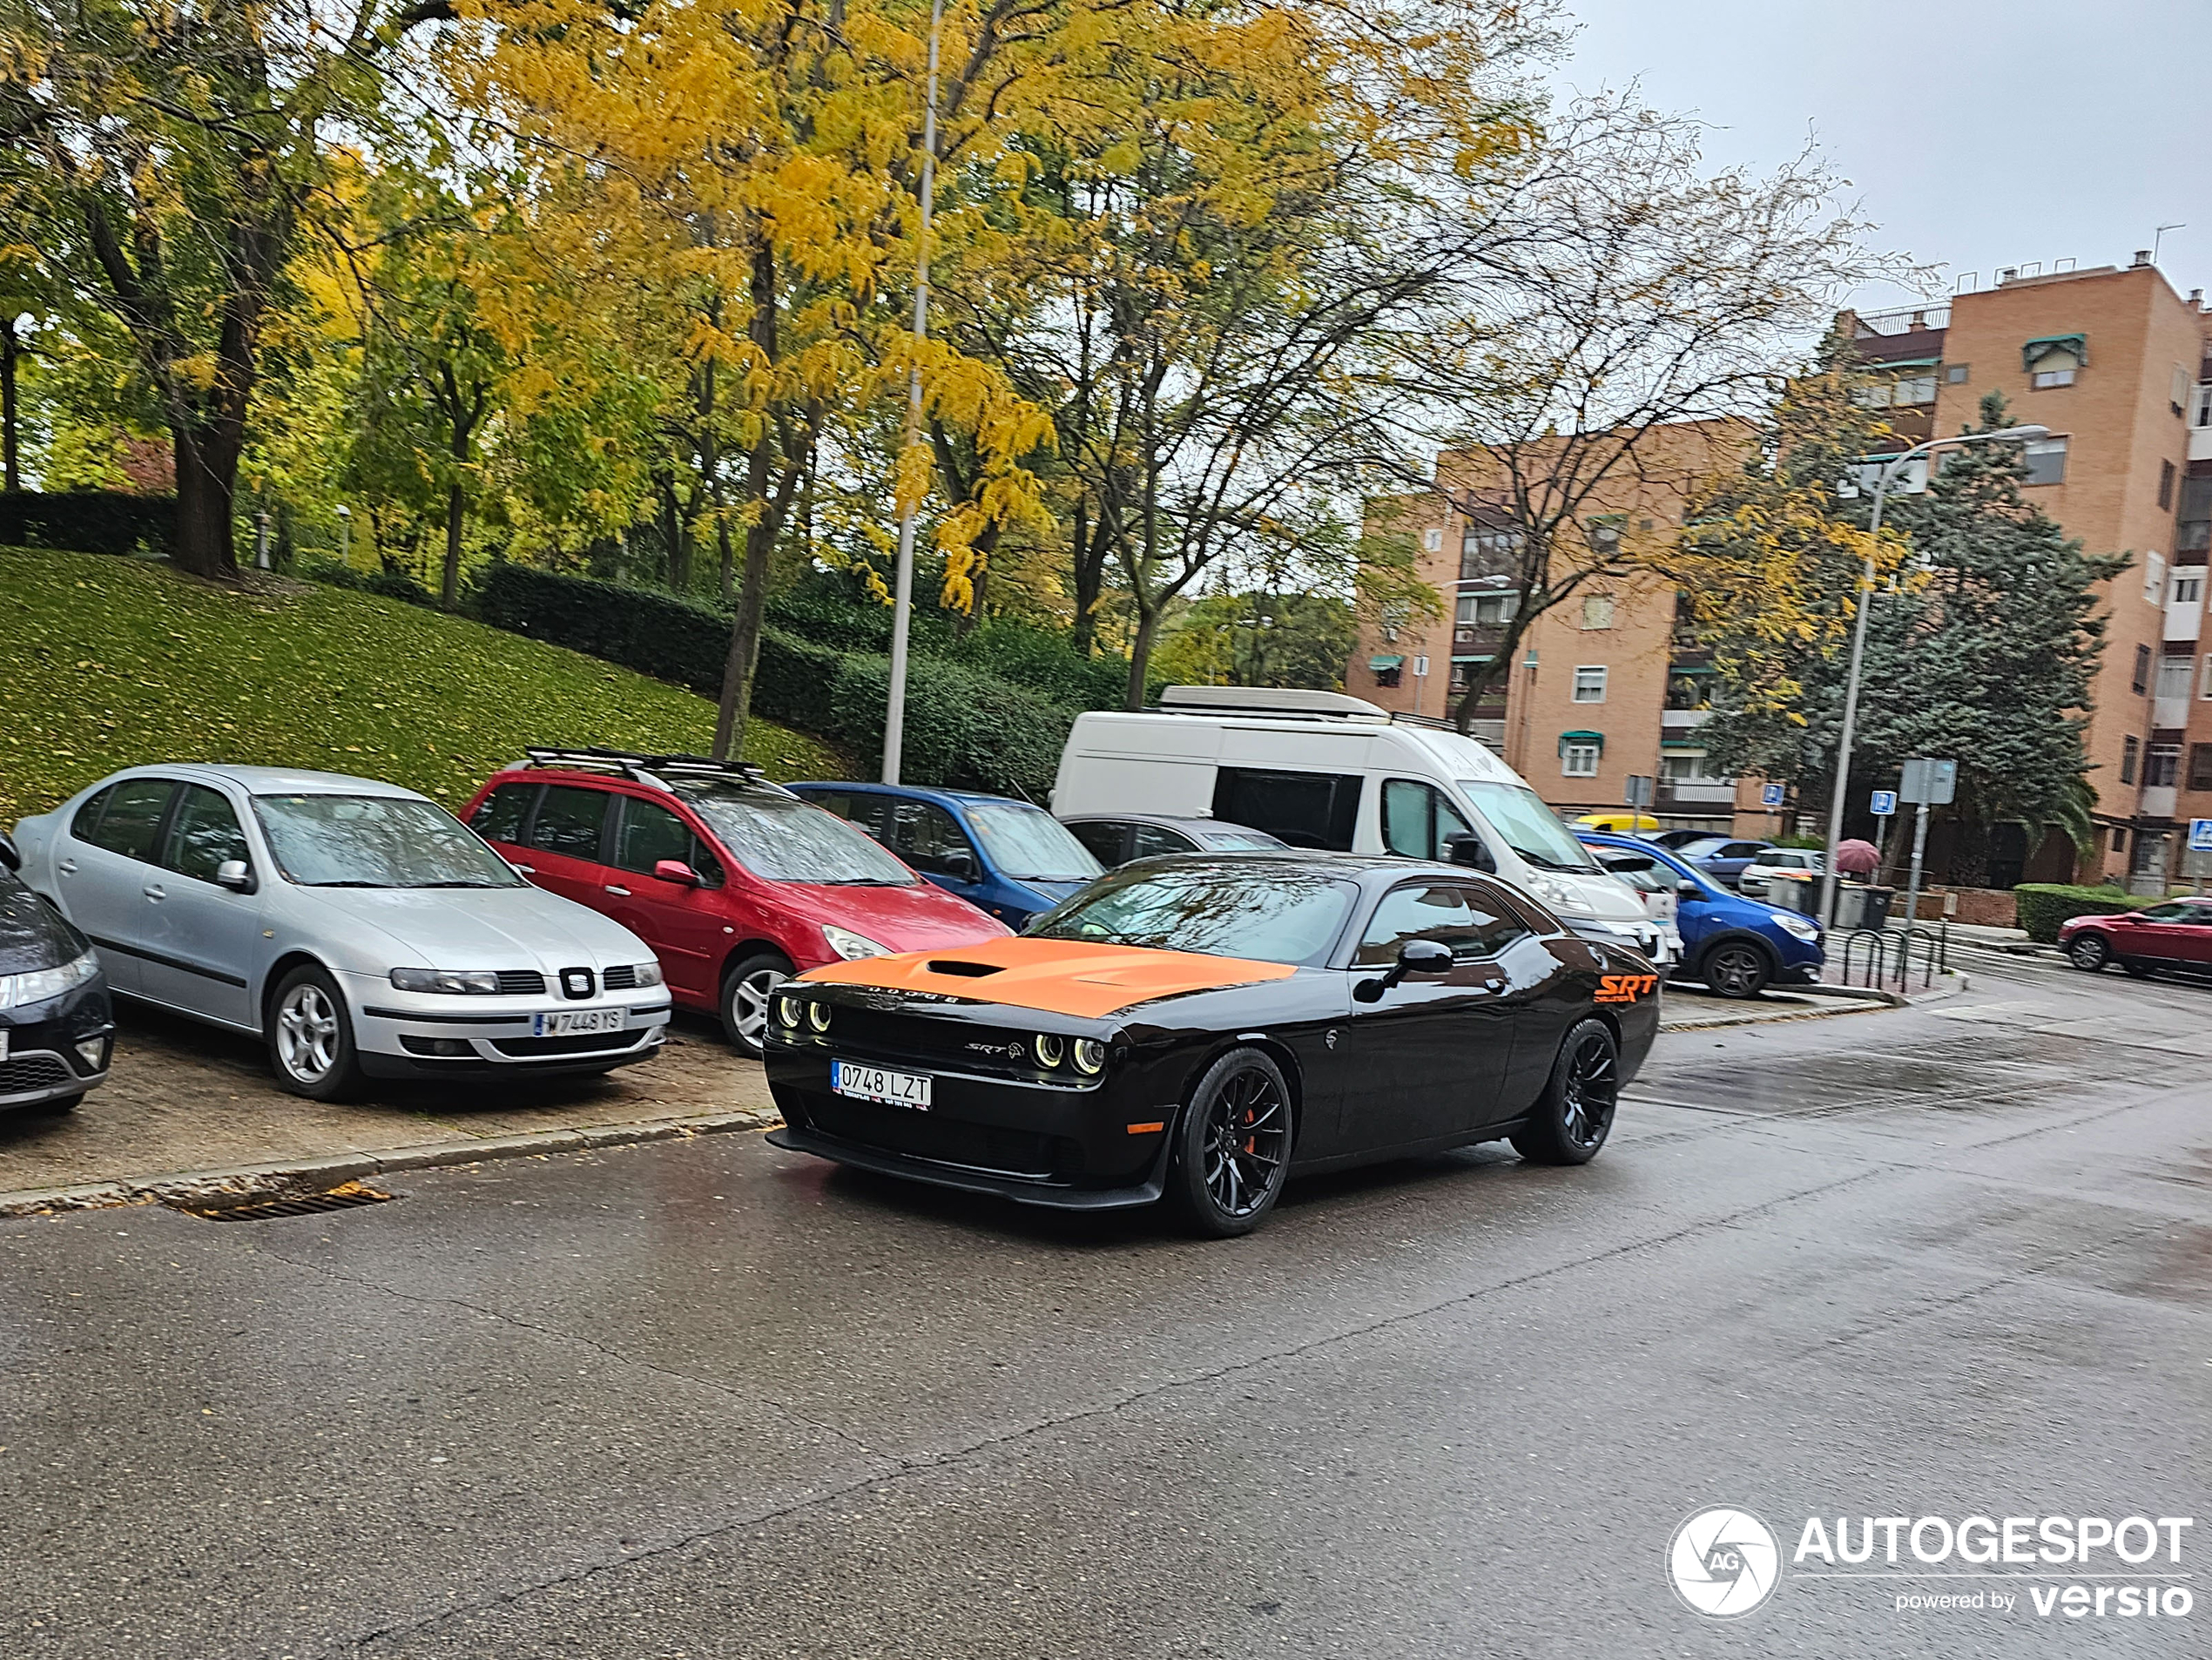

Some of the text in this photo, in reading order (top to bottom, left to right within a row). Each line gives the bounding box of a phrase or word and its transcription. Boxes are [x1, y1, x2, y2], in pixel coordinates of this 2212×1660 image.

[868, 987, 959, 1003] DODGE
[1593, 975, 1658, 1003] SRT
[560, 1013, 599, 1032] 7448
[601, 1011, 619, 1029] YS
[964, 1043, 1007, 1055] SRT
[842, 1065, 884, 1093] 0748
[891, 1074, 927, 1101] LZT
